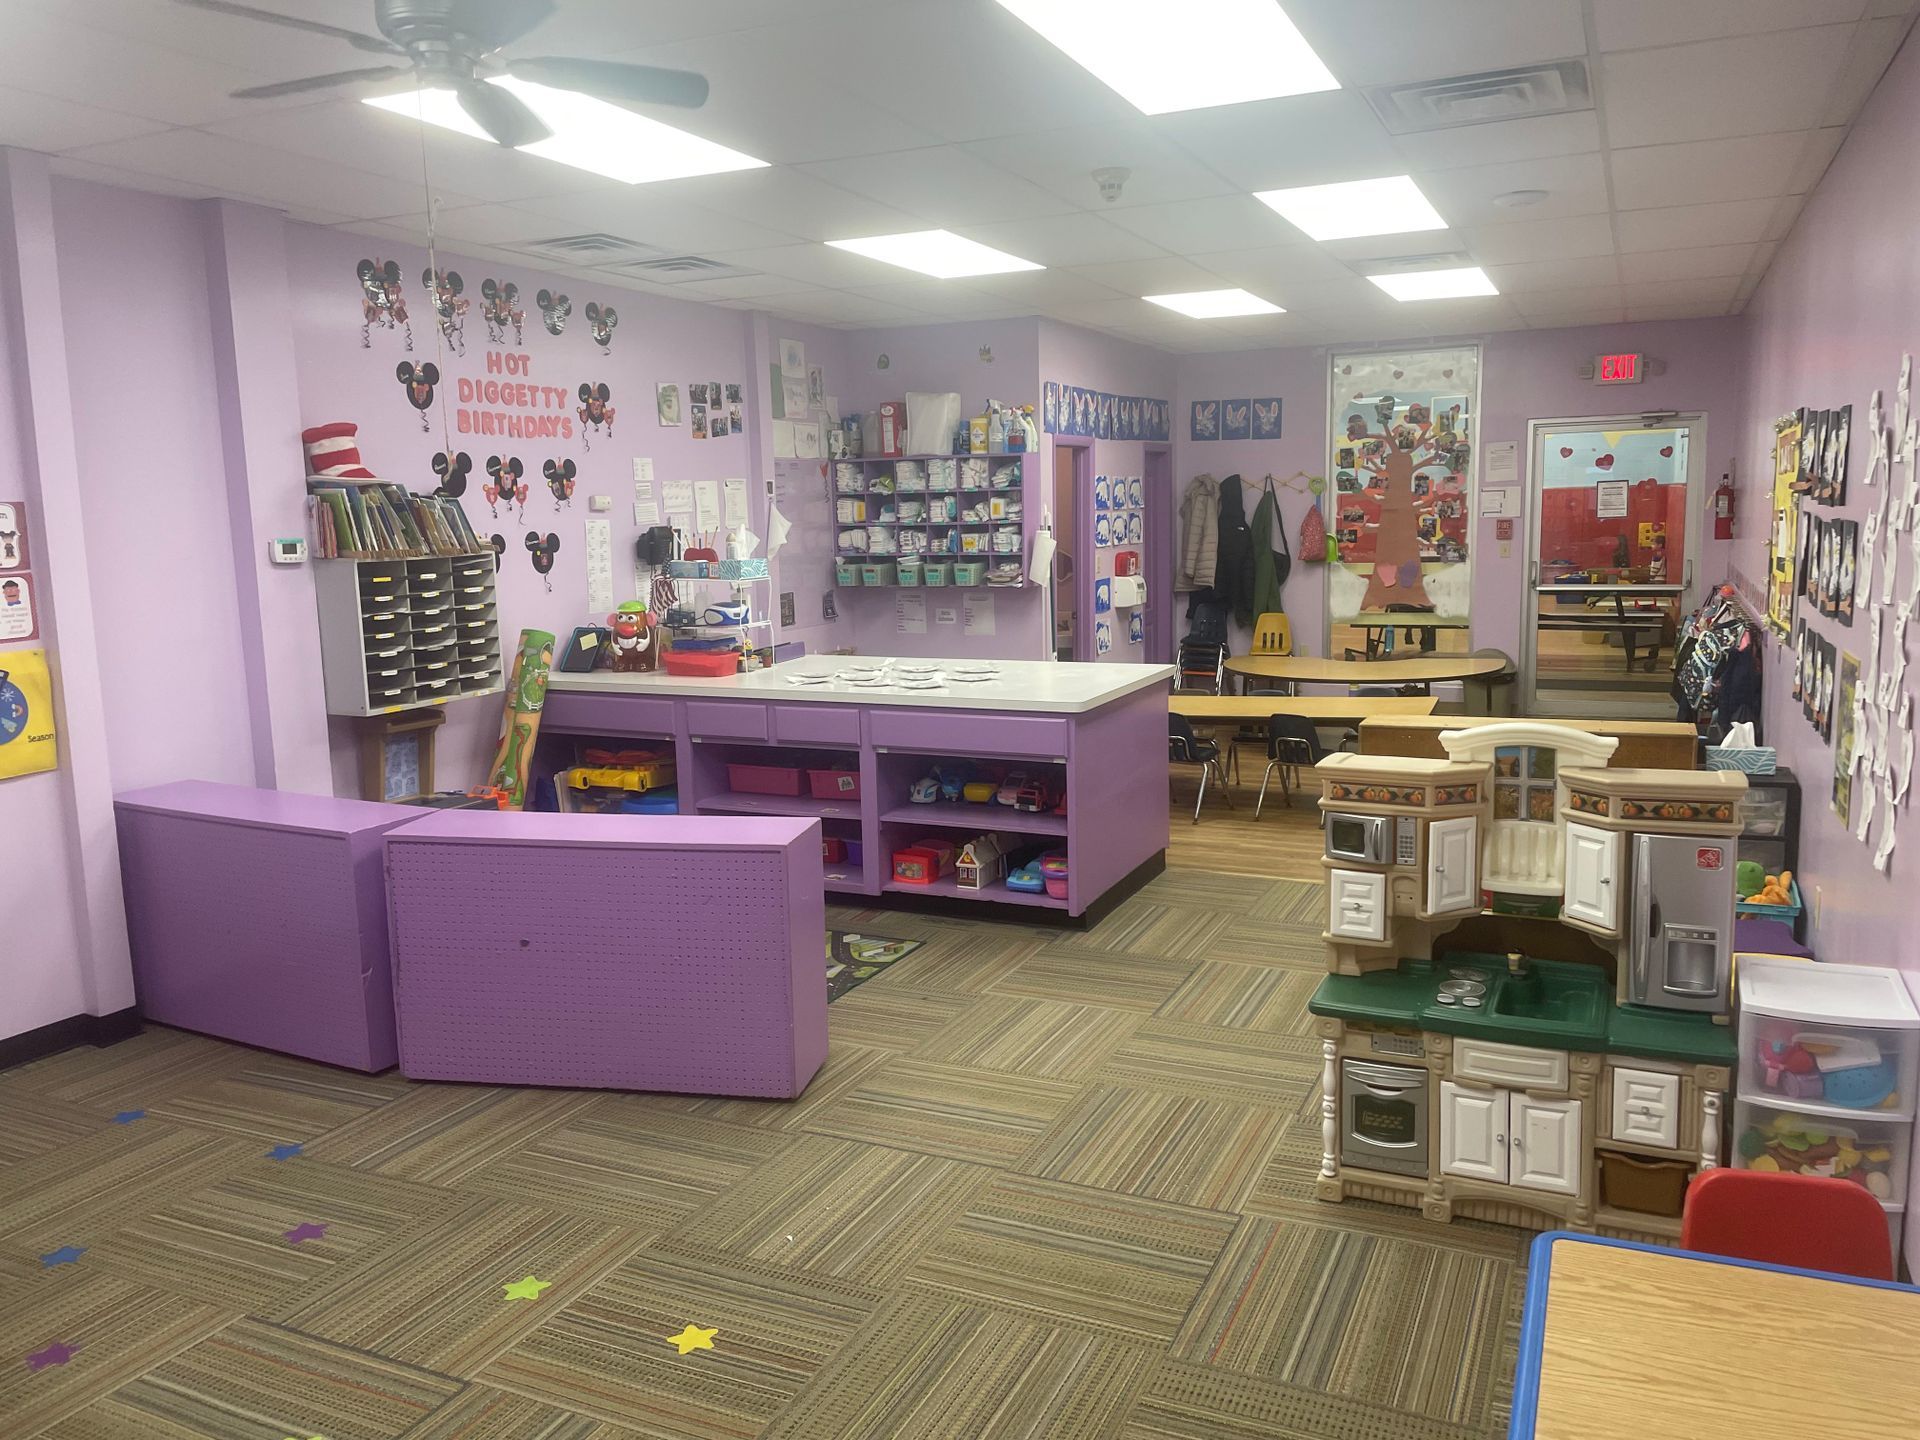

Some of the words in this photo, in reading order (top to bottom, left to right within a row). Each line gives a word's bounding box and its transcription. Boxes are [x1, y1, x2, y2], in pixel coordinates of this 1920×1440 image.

[487, 351, 530, 376] HOT
[1601, 354, 1637, 380] EXIT
[457, 377, 567, 410] DIGGETTY
[457, 409, 574, 439] BIRTHDAYS
